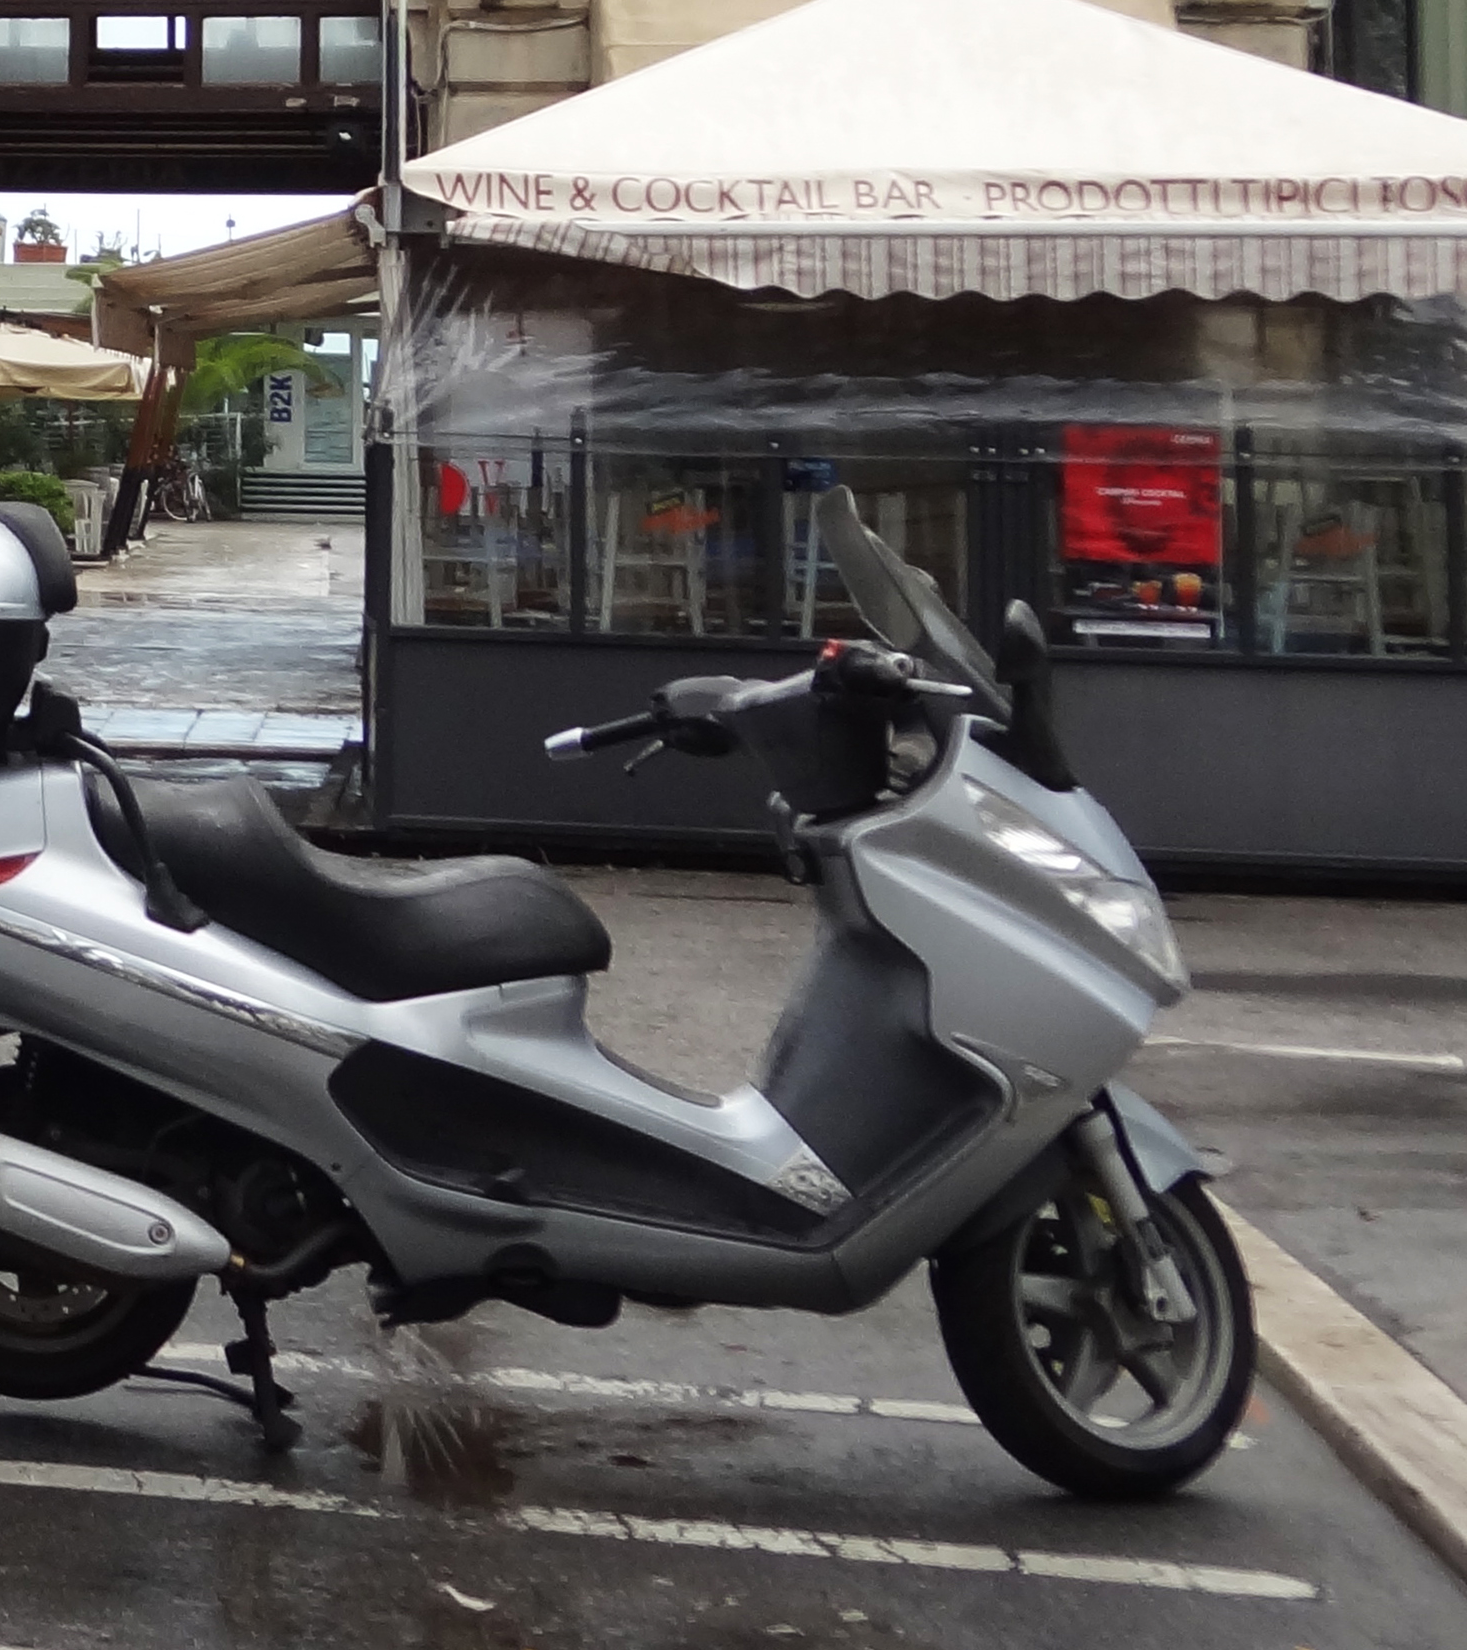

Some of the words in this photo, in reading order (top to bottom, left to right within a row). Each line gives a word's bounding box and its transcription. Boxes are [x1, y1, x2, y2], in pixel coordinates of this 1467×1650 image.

[435, 172, 556, 211] WINE
[569, 176, 597, 212] &
[611, 176, 839, 214] COCKTAIL
[853, 179, 942, 210] BAR
[984, 179, 1220, 214] PRODOTTI
[1230, 177, 1359, 214] TIPICI
[269, 374, 293, 423] B2K
